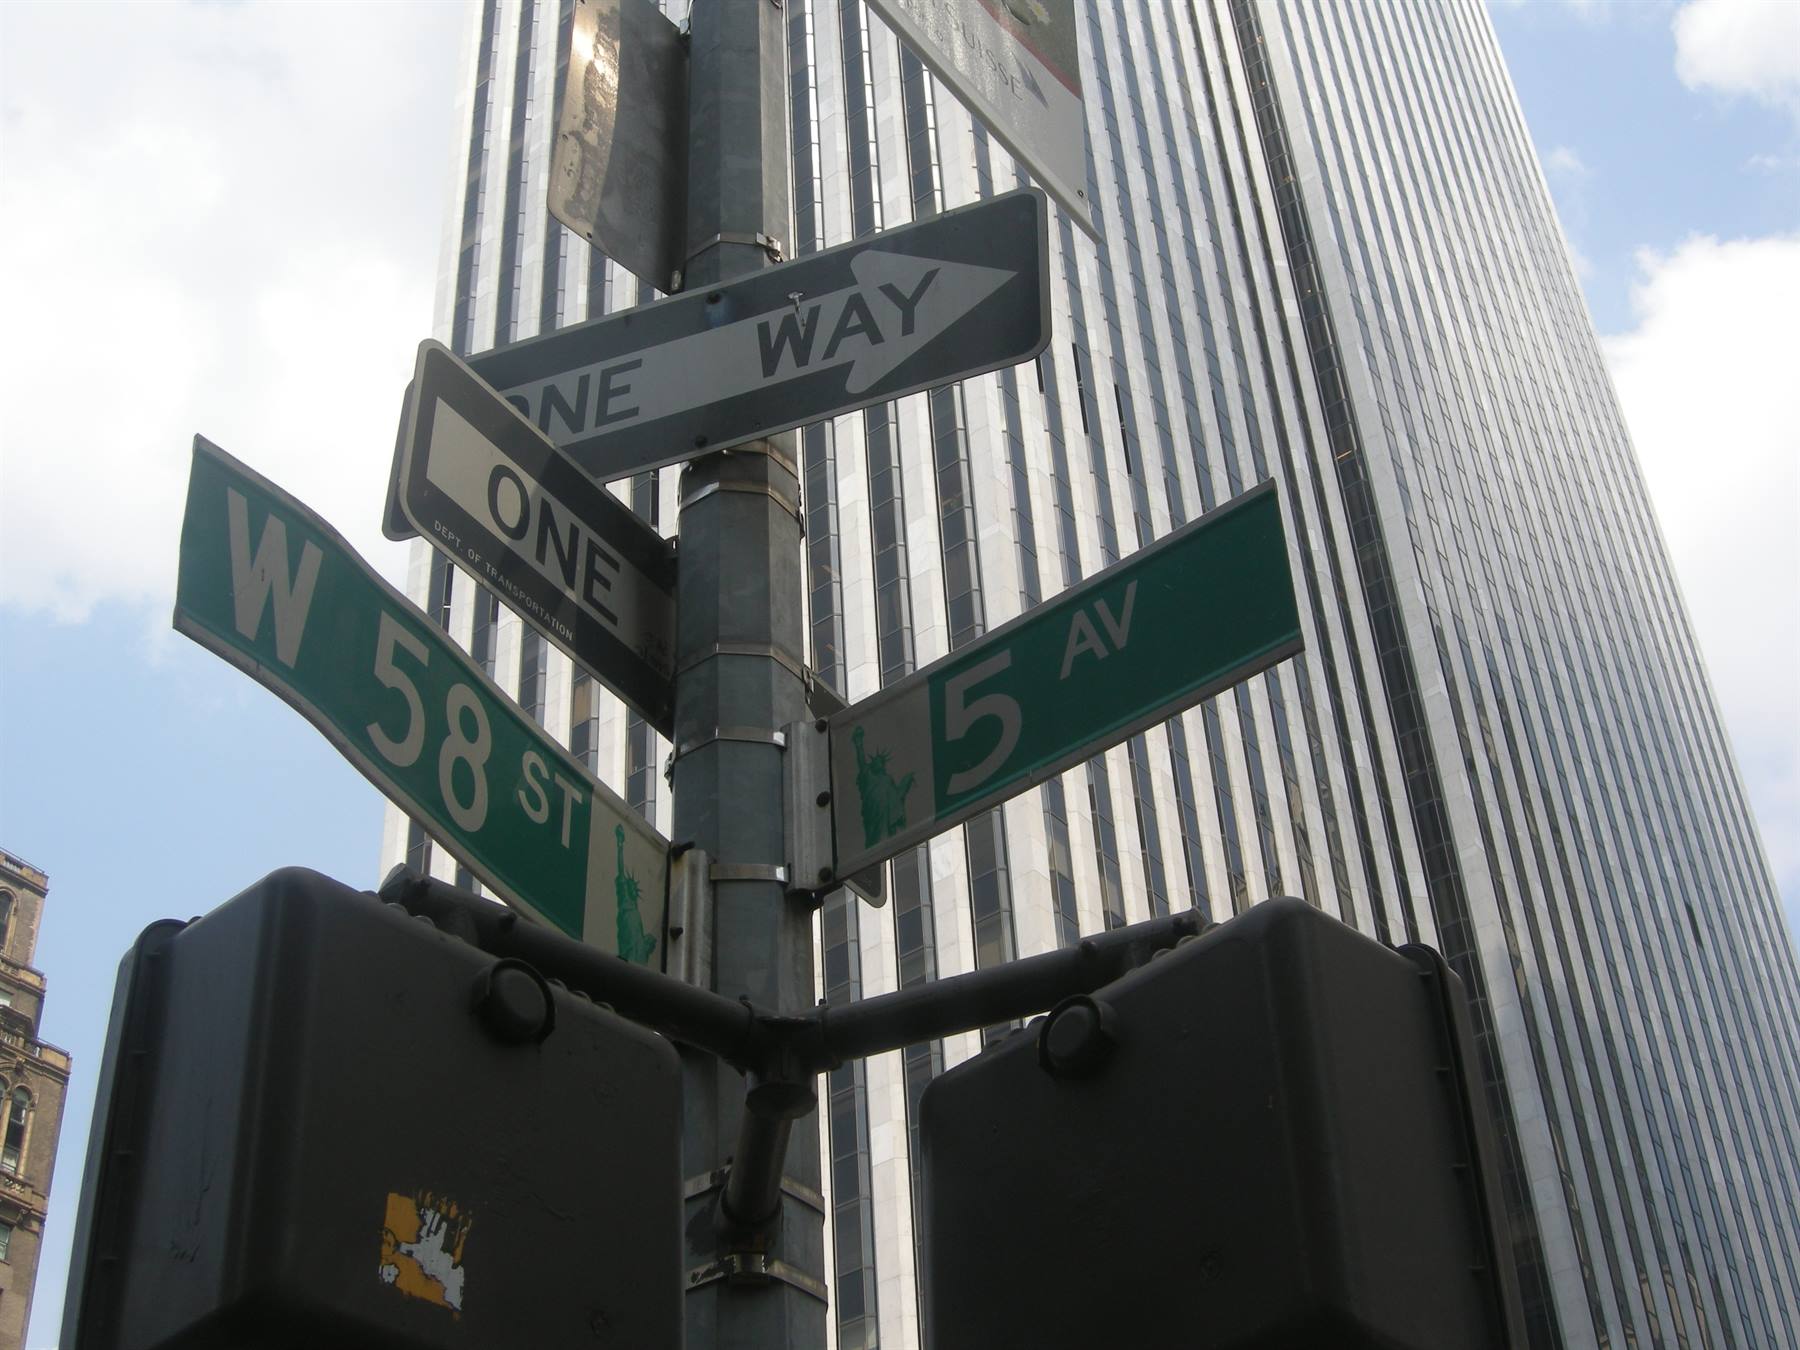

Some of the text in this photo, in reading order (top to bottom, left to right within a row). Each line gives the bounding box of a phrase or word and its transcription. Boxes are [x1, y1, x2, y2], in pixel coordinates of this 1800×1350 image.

[757, 267, 942, 379] WAY
[434, 520, 574, 641] DEPT. OF TRANSPORTATION
[487, 464, 621, 627] ONE
[227, 486, 583, 849] W 58 ST
[944, 580, 1138, 796] 5 AV
